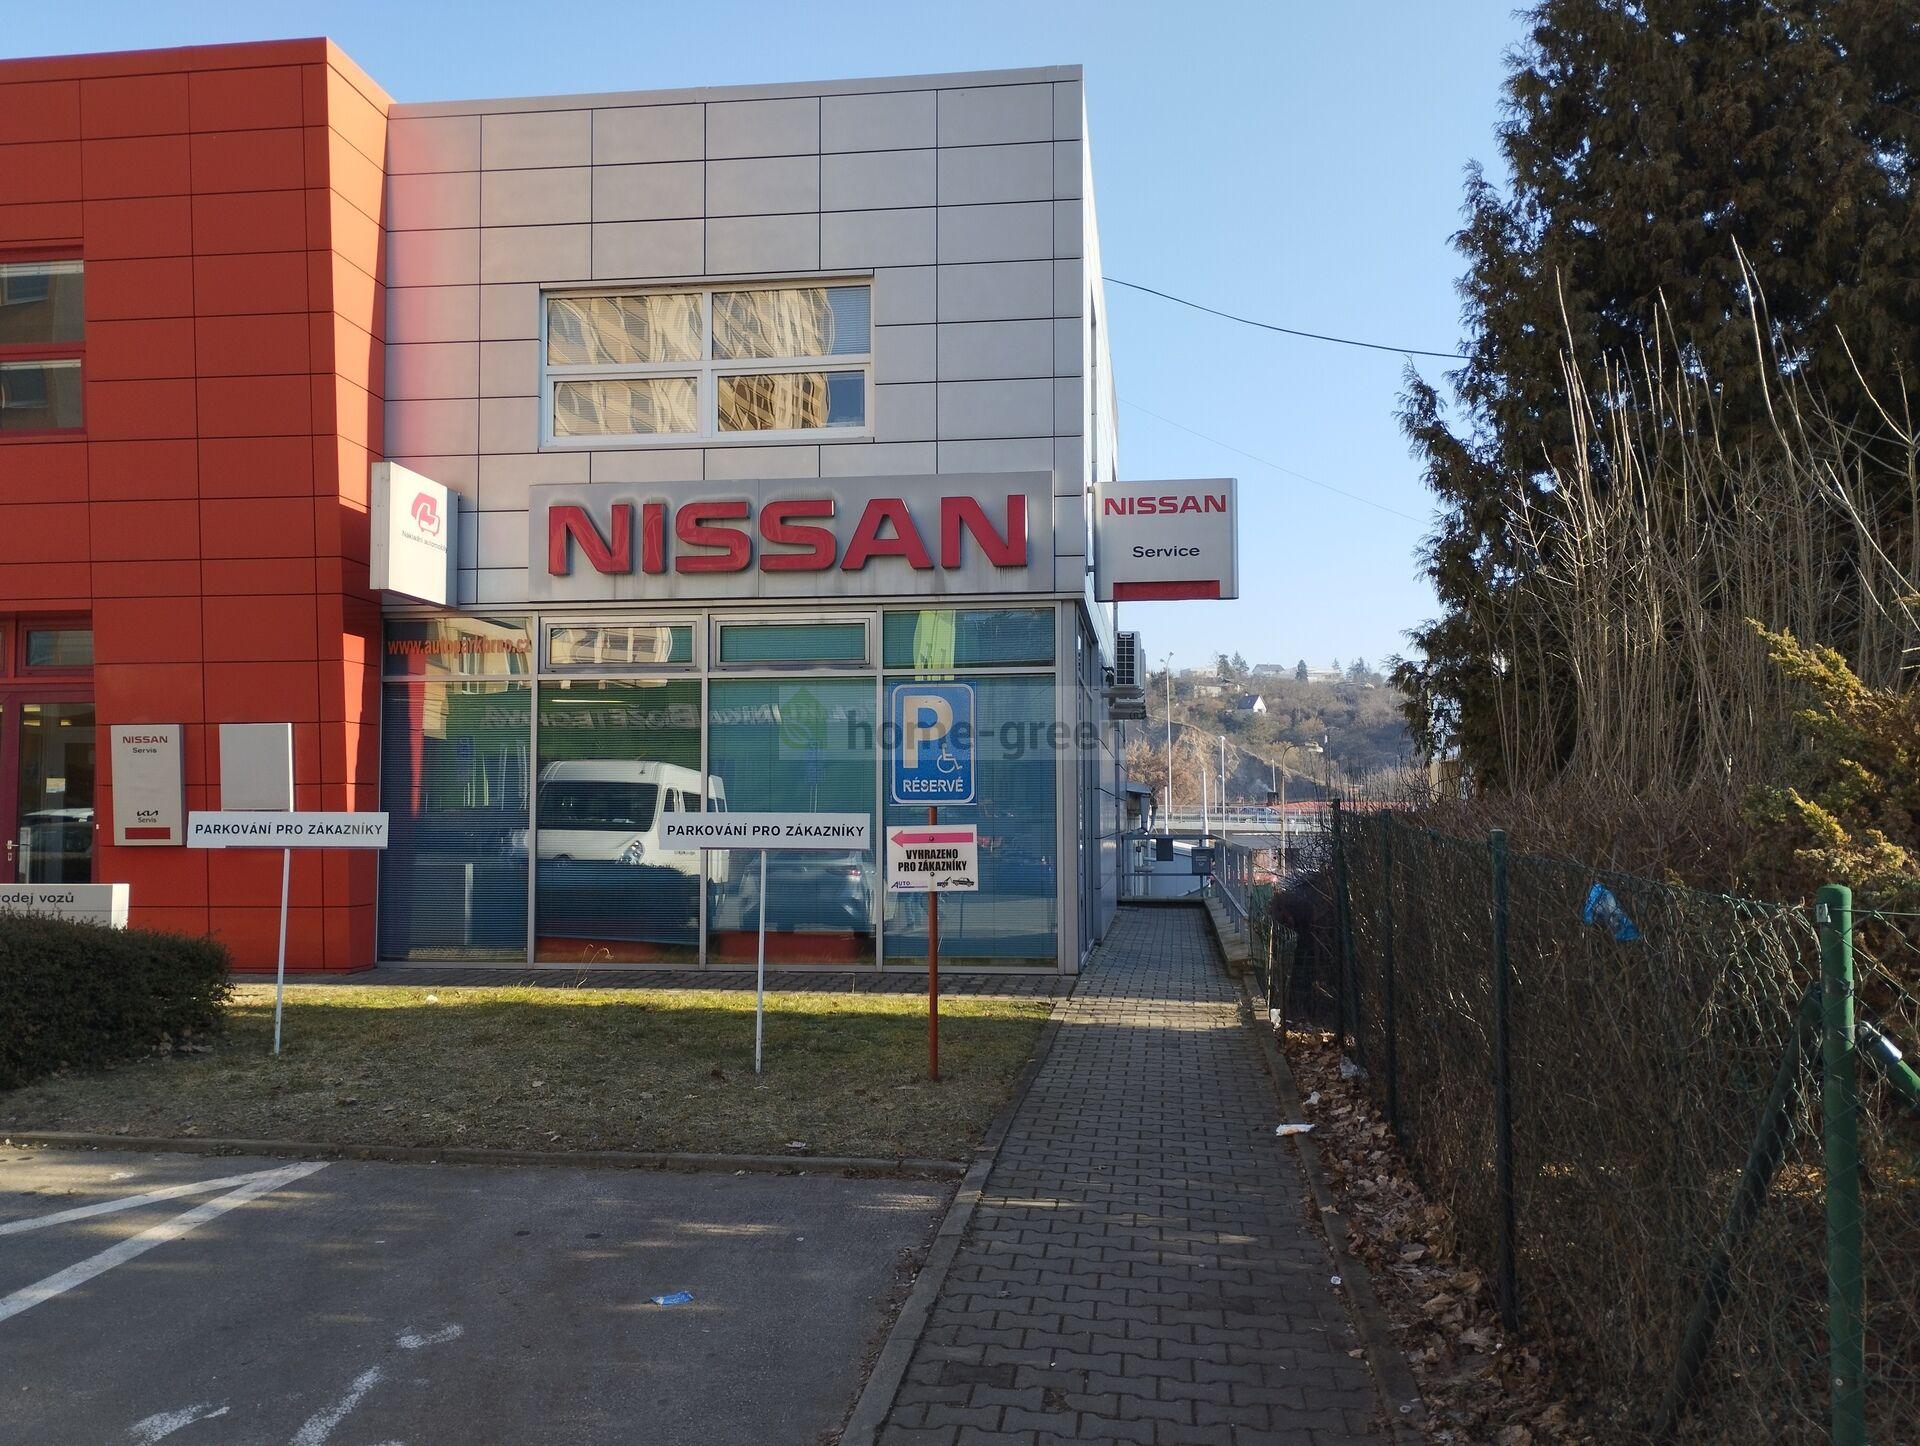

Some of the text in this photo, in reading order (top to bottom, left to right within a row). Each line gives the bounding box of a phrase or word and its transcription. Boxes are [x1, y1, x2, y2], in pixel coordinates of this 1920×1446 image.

[1104, 494, 1227, 516] NISSAN
[548, 494, 1029, 576] NISSAN
[1132, 545, 1200, 558] Service
[903, 695, 953, 769] P
[122, 736, 168, 744] NISSAN
[903, 777, 964, 793] RÉSERVÉ
[195, 822, 383, 835] PARKOVÁNÍ PRO ZÁKAZNÍKY
[667, 823, 865, 837] PARKOVÁNÍ PRO ZÁKAZNÍKY
[906, 849, 959, 859] VYHRAZENO
[898, 860, 967, 872] PRO ZÁKAZNÍKY
[0, 892, 74, 904] odej vozů
